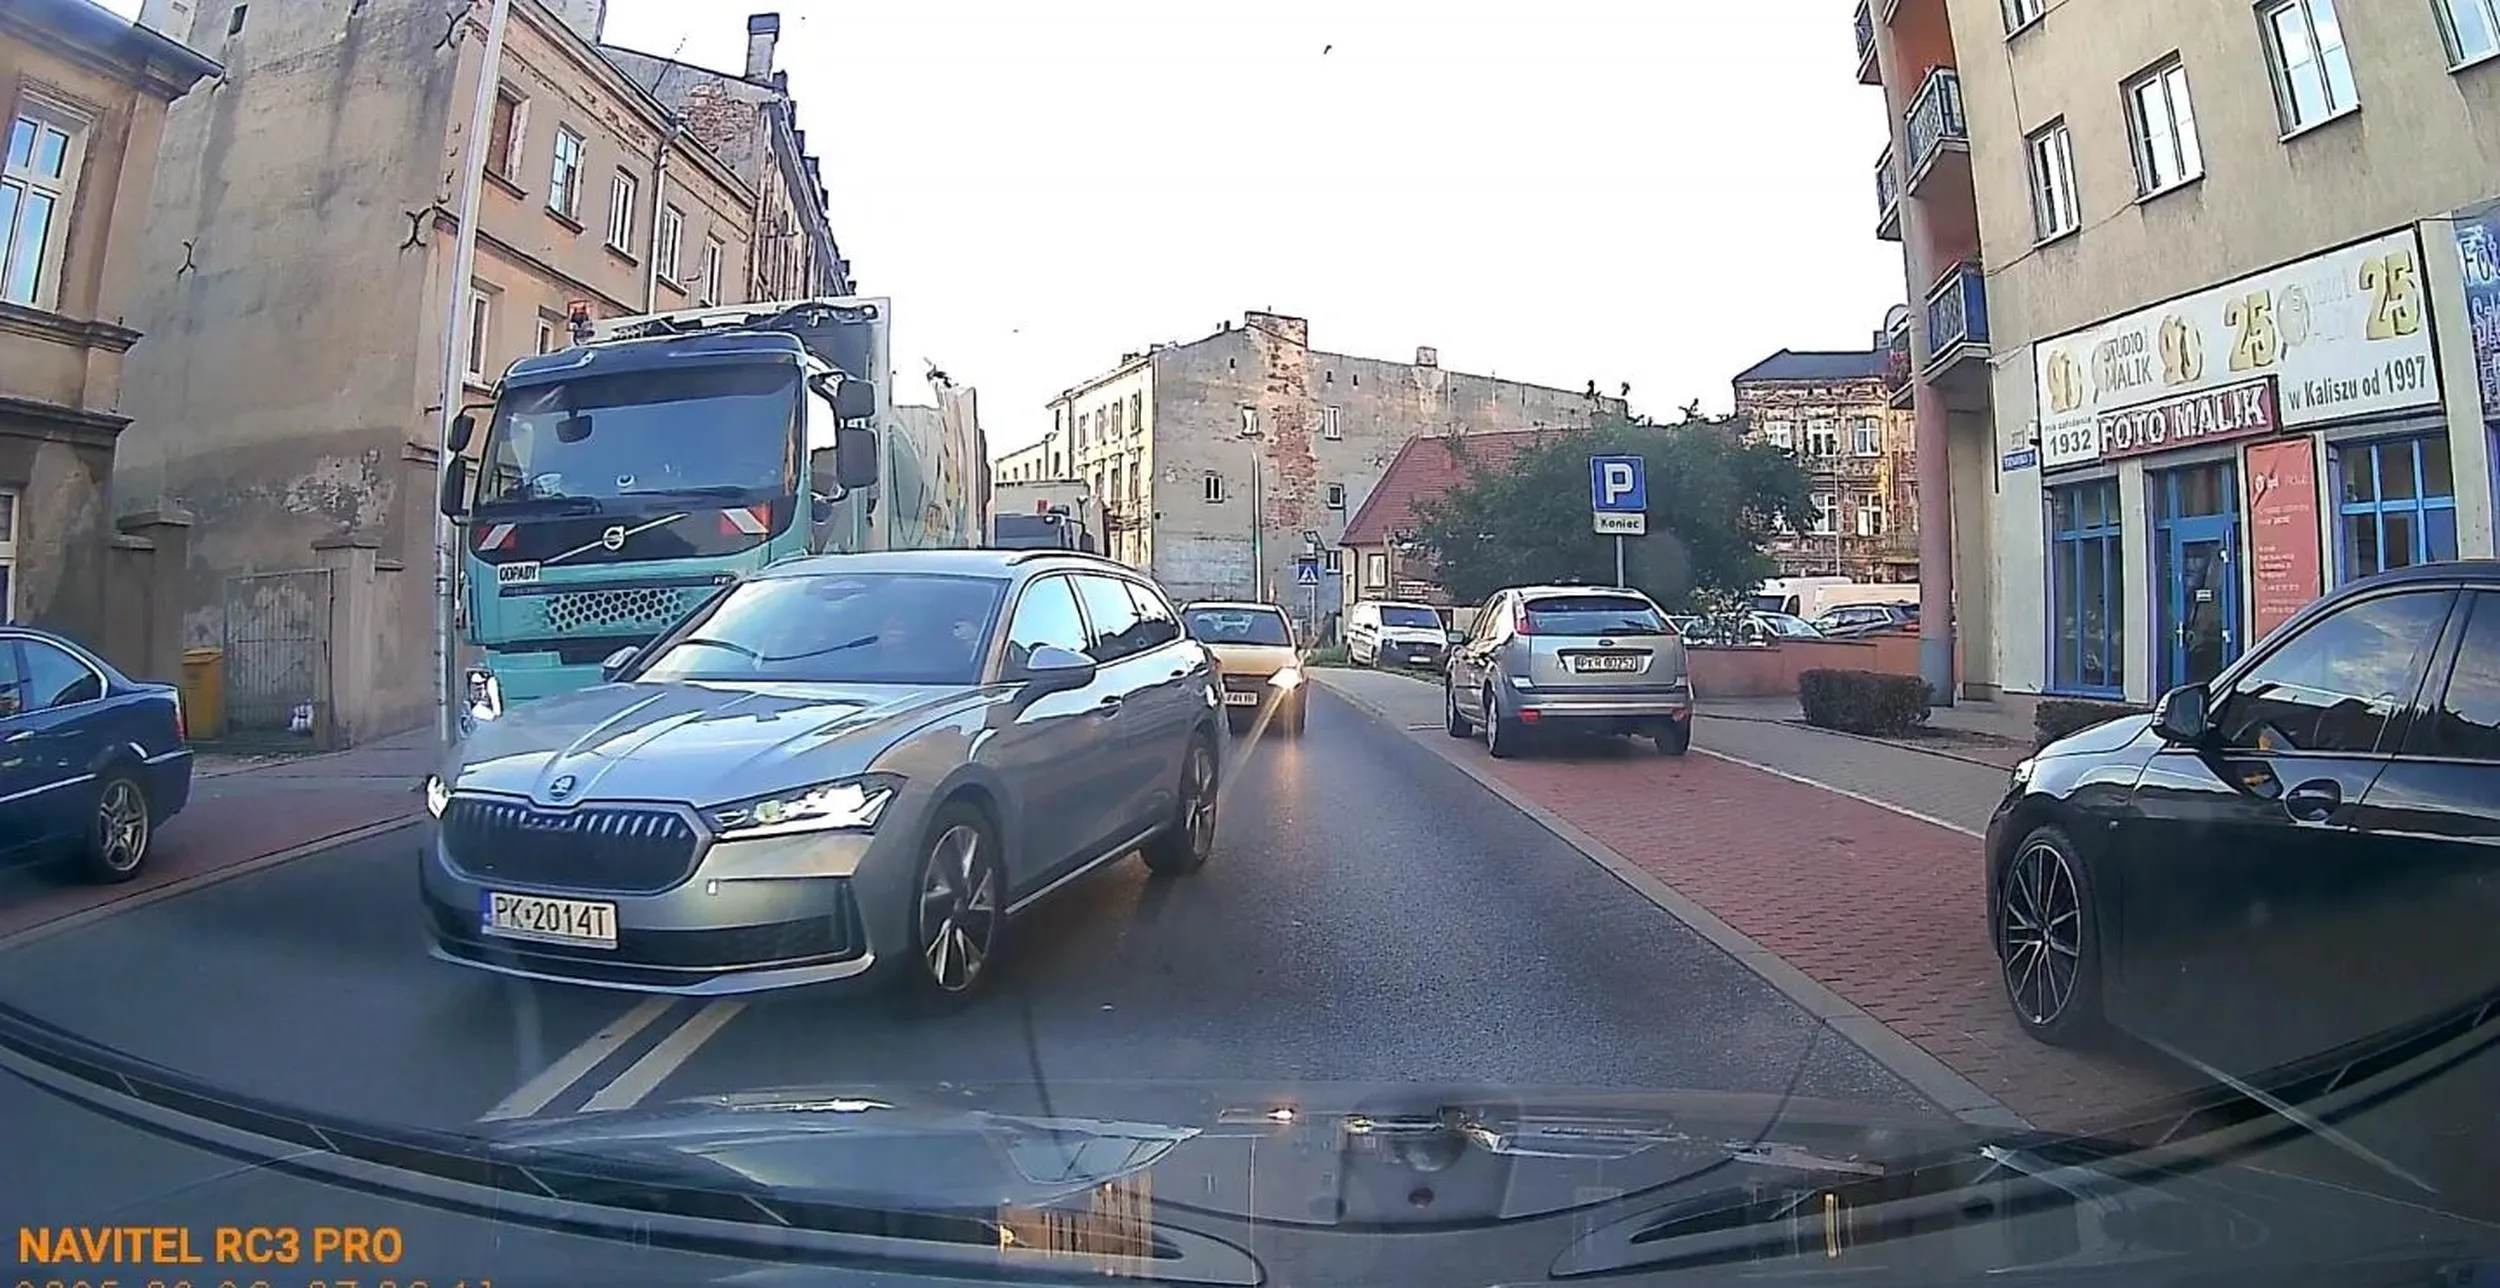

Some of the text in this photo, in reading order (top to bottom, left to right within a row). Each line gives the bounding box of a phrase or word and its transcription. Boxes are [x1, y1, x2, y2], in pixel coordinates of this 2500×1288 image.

[2359, 250, 2420, 340] 25
[2103, 331, 2144, 363] STUDIO
[2224, 289, 2277, 372] 25
[2105, 354, 2153, 393] MALIK
[2288, 355, 2426, 411] w Kaliszu od 1997
[2100, 385, 2267, 453] FOTO MALIK
[2050, 428, 2092, 457] 1932
[1604, 463, 1634, 504] P
[1600, 519, 1640, 530] Koniec
[532, 900, 609, 937] 2014T
